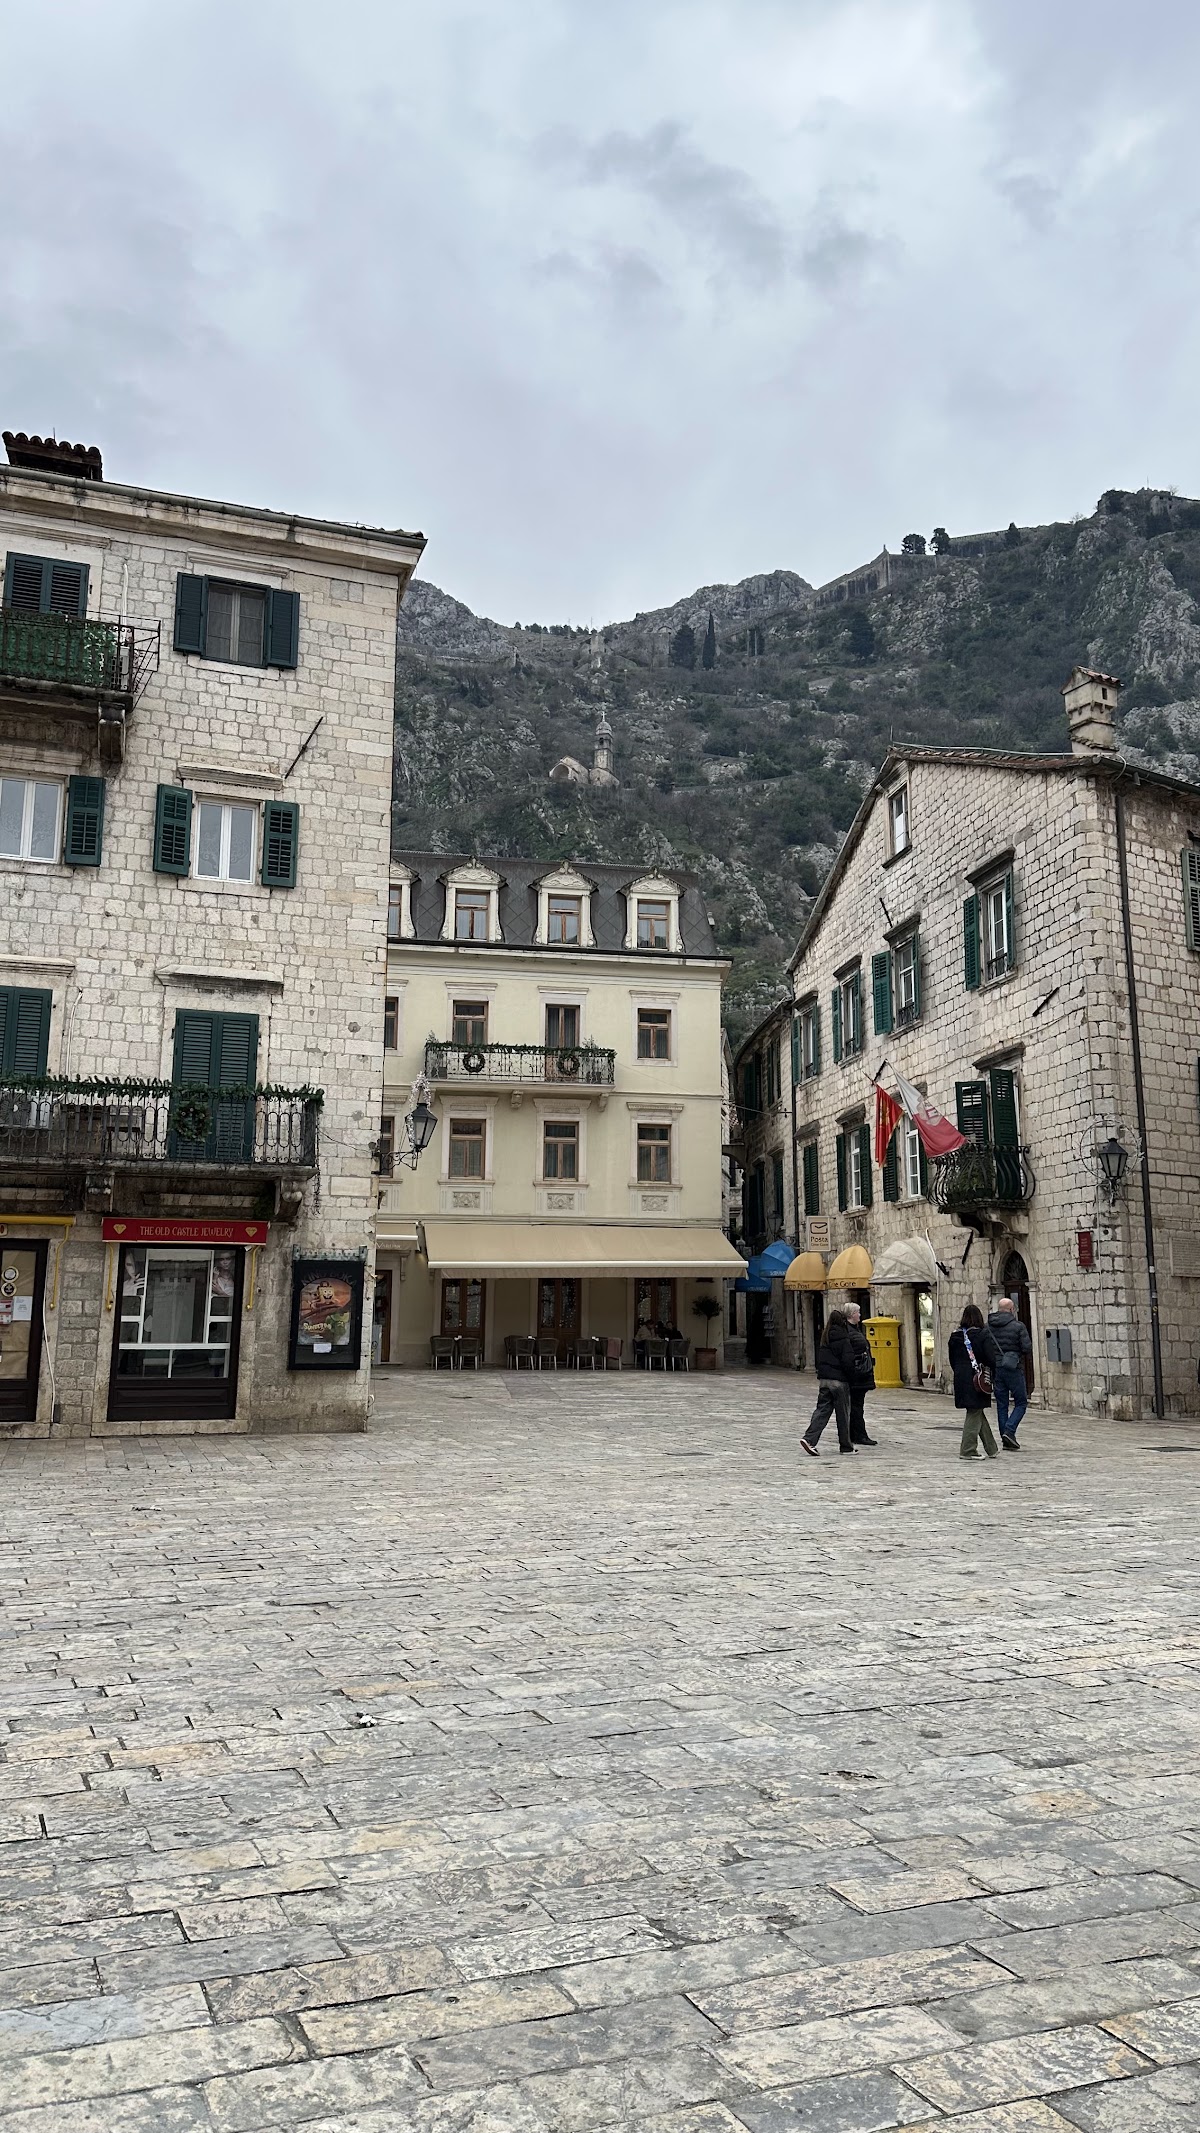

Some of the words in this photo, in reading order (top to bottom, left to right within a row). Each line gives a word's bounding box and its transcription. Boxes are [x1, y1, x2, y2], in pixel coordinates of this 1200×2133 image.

[140, 1226, 154, 1236] THE
[154, 1226, 171, 1236] OLD
[171, 1226, 199, 1237] CASTLE
[200, 1227, 234, 1239] JEWELRY
[839, 1280, 856, 1288] Gore
